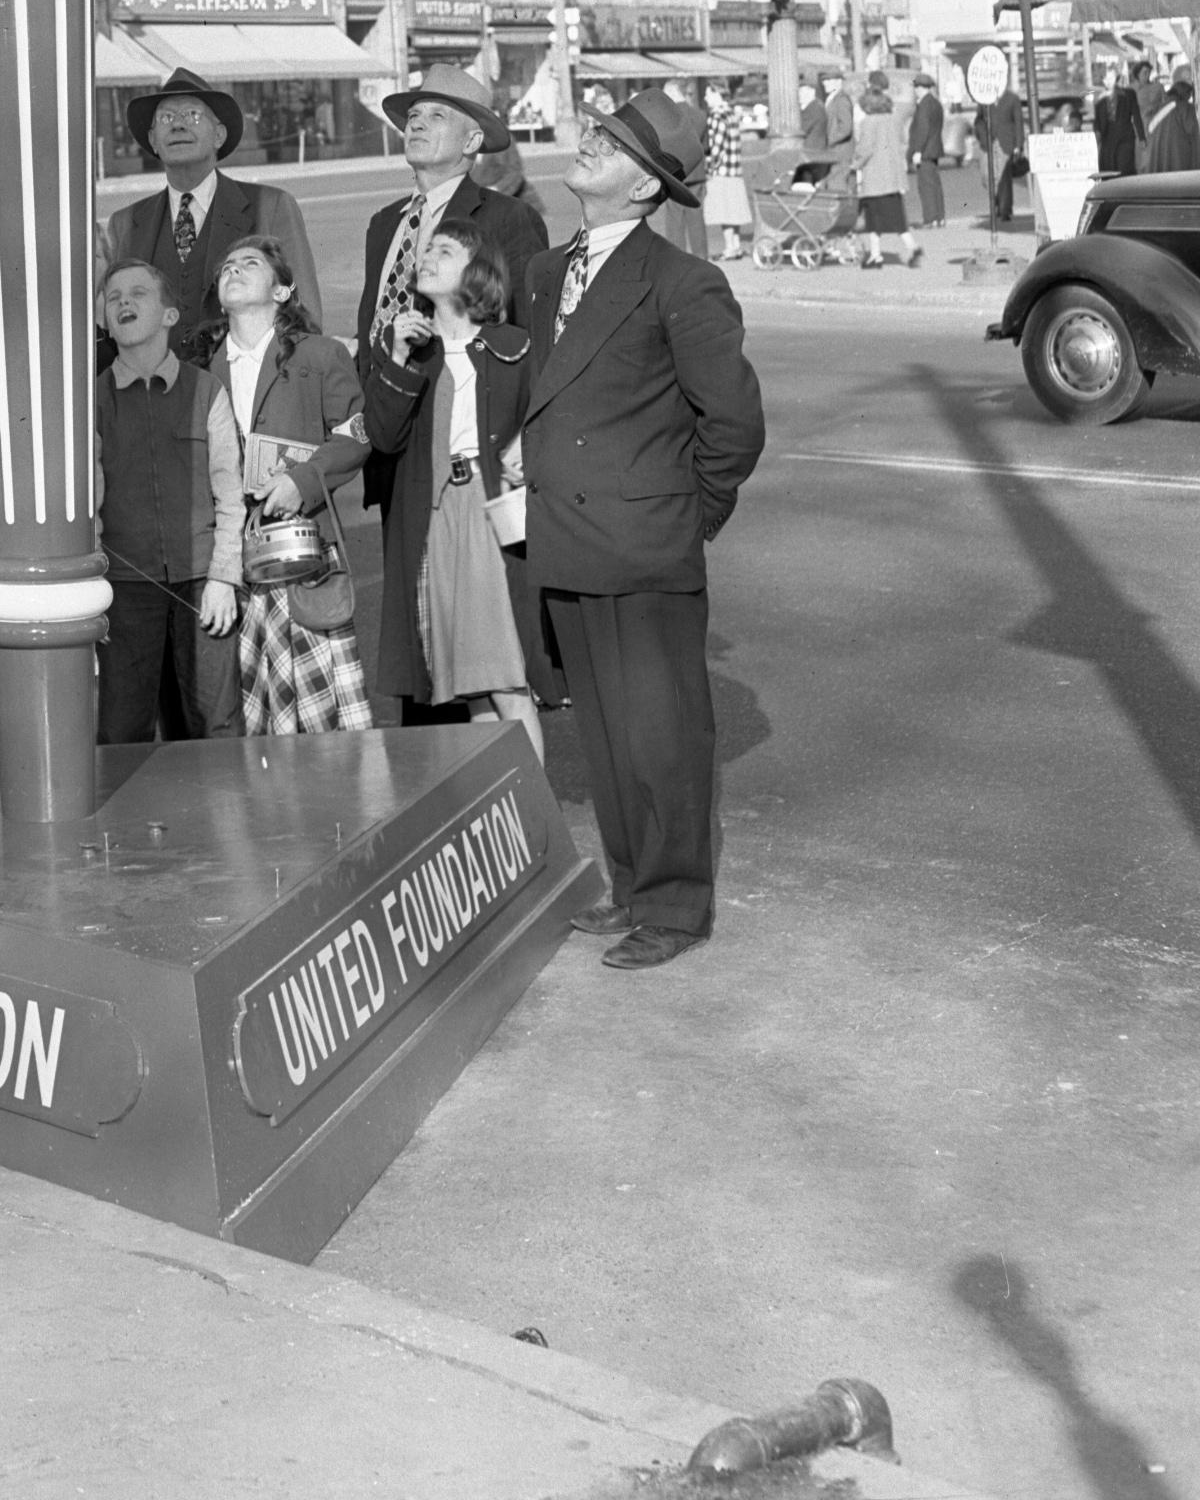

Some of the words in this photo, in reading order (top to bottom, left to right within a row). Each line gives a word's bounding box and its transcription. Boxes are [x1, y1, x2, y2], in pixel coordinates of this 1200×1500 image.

[638, 14, 696, 42] CLOTHES
[982, 53, 998, 65] NO
[971, 66, 1004, 81] RIGHT
[973, 81, 1000, 95] TURN
[268, 918, 385, 1086] UNITED
[381, 790, 532, 985] FOUNDATION
